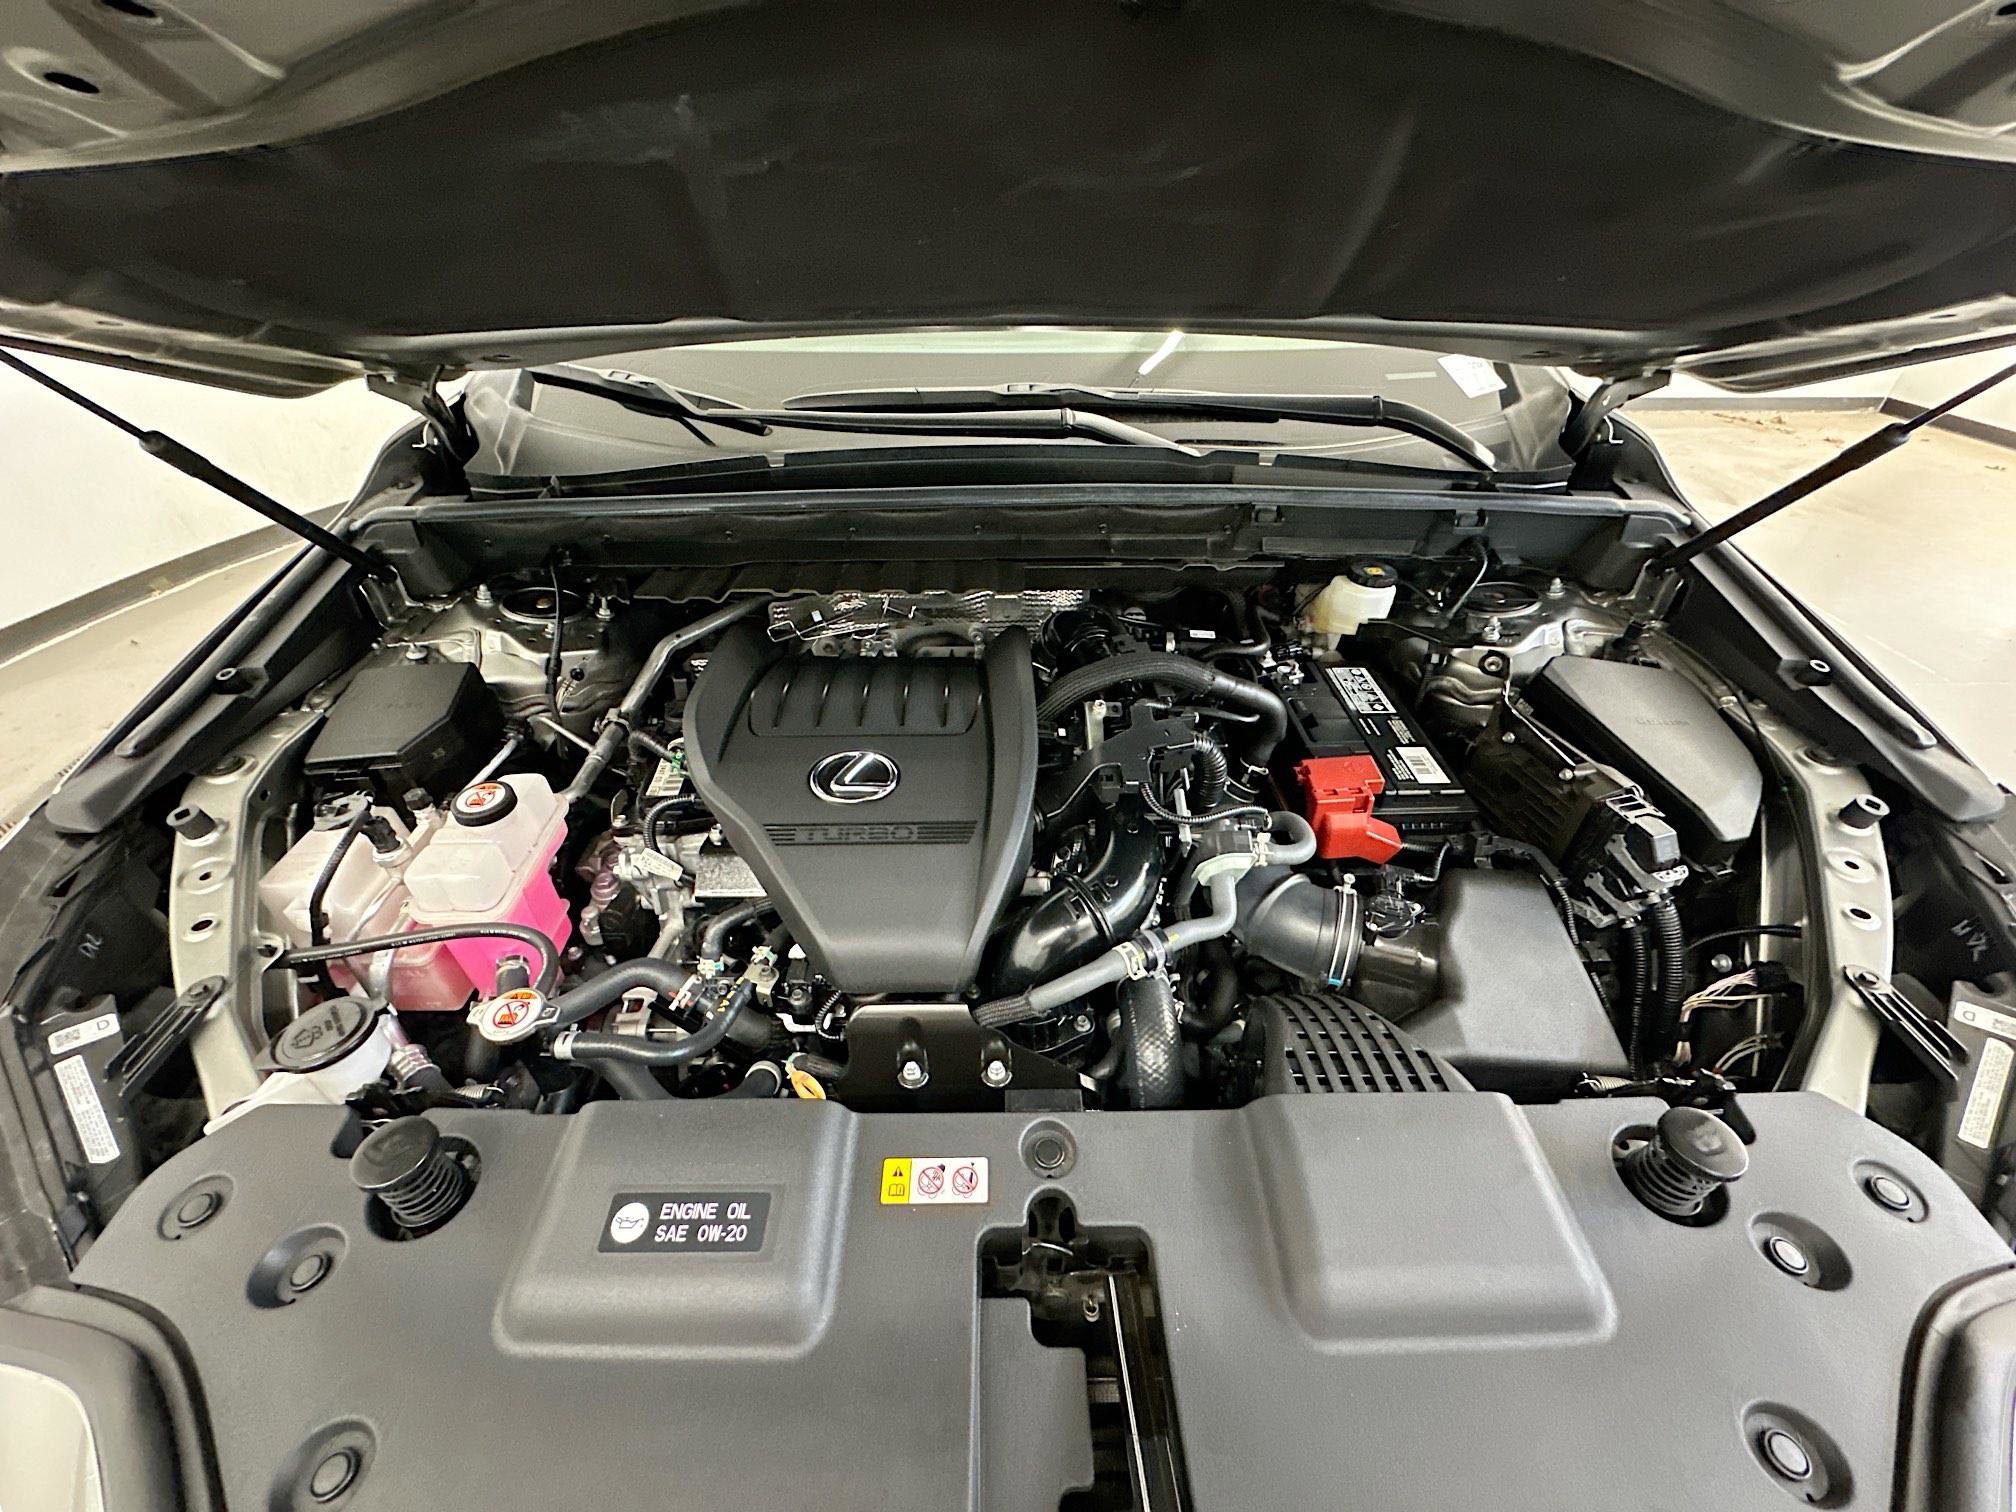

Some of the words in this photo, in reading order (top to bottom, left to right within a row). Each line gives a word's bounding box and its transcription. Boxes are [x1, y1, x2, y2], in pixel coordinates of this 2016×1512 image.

[799, 825, 915, 842] TURBO
[659, 1202, 719, 1220] ENGINE
[726, 1202, 752, 1220] OIL
[654, 1224, 690, 1243] SAE
[696, 1224, 748, 1243] 0W-20
